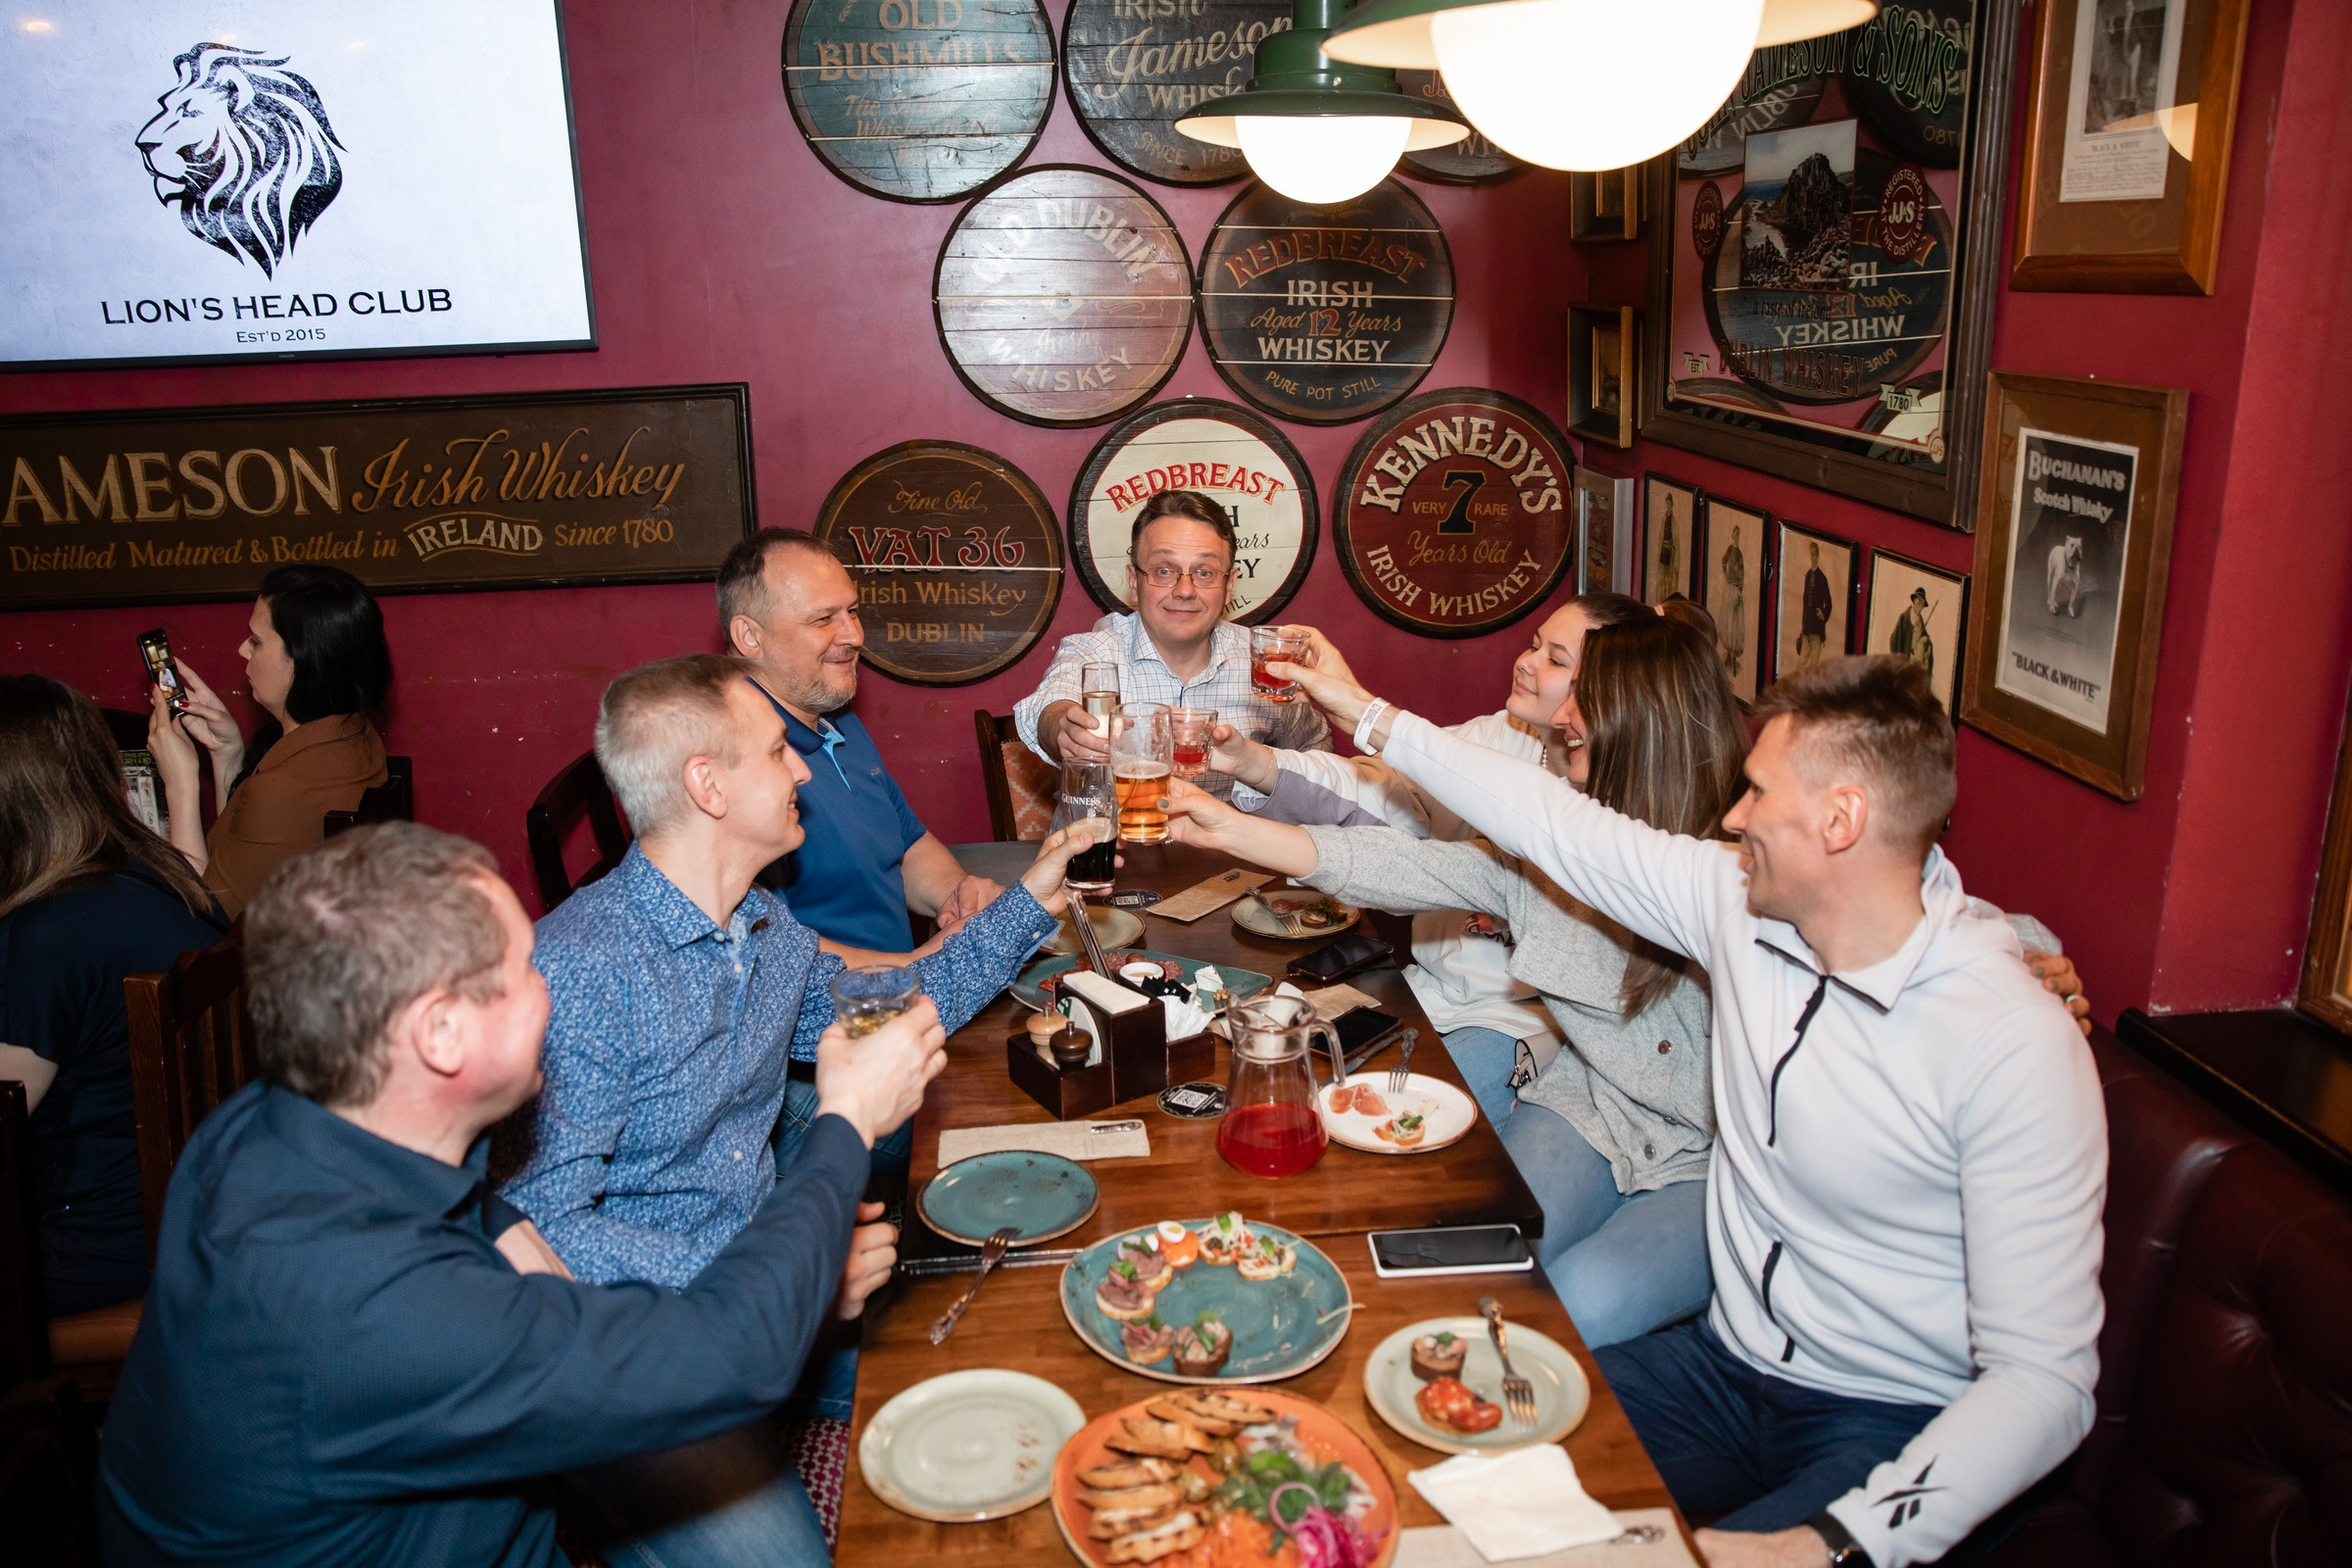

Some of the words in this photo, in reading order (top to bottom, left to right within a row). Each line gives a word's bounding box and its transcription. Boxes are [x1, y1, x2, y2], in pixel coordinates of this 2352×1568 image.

[879, 0, 963, 31] OLD
[817, 40, 1024, 81] BUSHMILLS
[1094, 15, 1293, 100] Jameson
[1877, 5, 1959, 115] SONS
[1145, 66, 1246, 110] WHISK
[1885, 169, 1923, 198] REGISTERED
[1036, 200, 1159, 282] DUBLIN
[1224, 229, 1428, 289] REDBREAST
[100, 296, 224, 325] LION'S
[234, 292, 339, 320] HEAD
[348, 288, 454, 316] CLUB
[1287, 278, 1373, 309] IRISH
[285, 327, 327, 342] 2015
[1250, 307, 1307, 336] Aged
[1307, 308, 1342, 337] 12
[1345, 310, 1402, 339] Years
[987, 336, 1135, 392] WHISKEY
[1257, 337, 1392, 363] WHISKEY
[1264, 370, 1300, 395] PURE
[1305, 387, 1334, 401] POT
[1341, 376, 1382, 399] STILL
[1889, 395, 1909, 411] 1780
[2, 445, 345, 527] AMESON
[351, 428, 511, 515] Irish
[500, 425, 685, 512] Whiskey
[1359, 416, 1563, 514] KENNEDY'S
[2028, 450, 2127, 492] BUCHANAN'S
[887, 479, 941, 514] Fine
[945, 480, 988, 514] Old
[1104, 462, 1286, 514] REDBREAST
[1411, 502, 1447, 515] VERY
[1437, 469, 1488, 536] 7
[1474, 503, 1508, 516] RARE
[2033, 486, 2071, 513] Scotch
[9, 541, 116, 573] Distilled
[128, 538, 243, 568] Matured
[249, 539, 270, 564] &
[270, 530, 364, 564] Bottled
[371, 530, 399, 558] in
[407, 517, 545, 559] IRELAND
[554, 521, 618, 549] Since
[621, 518, 675, 550] 1780
[848, 525, 952, 573] VAT
[956, 525, 1025, 570] 36
[1234, 532, 1271, 550] ears
[1407, 530, 1468, 567] Years
[1473, 540, 1513, 565] Old
[914, 580, 1027, 616] Whiskey
[1366, 545, 1423, 608] IRISH
[1429, 549, 1543, 617] WHISKEY
[1222, 595, 1251, 616] TILL
[886, 621, 986, 643] DUBLIN
[2050, 668, 2059, 684] &
[1061, 793, 1102, 807] GUINNESS
